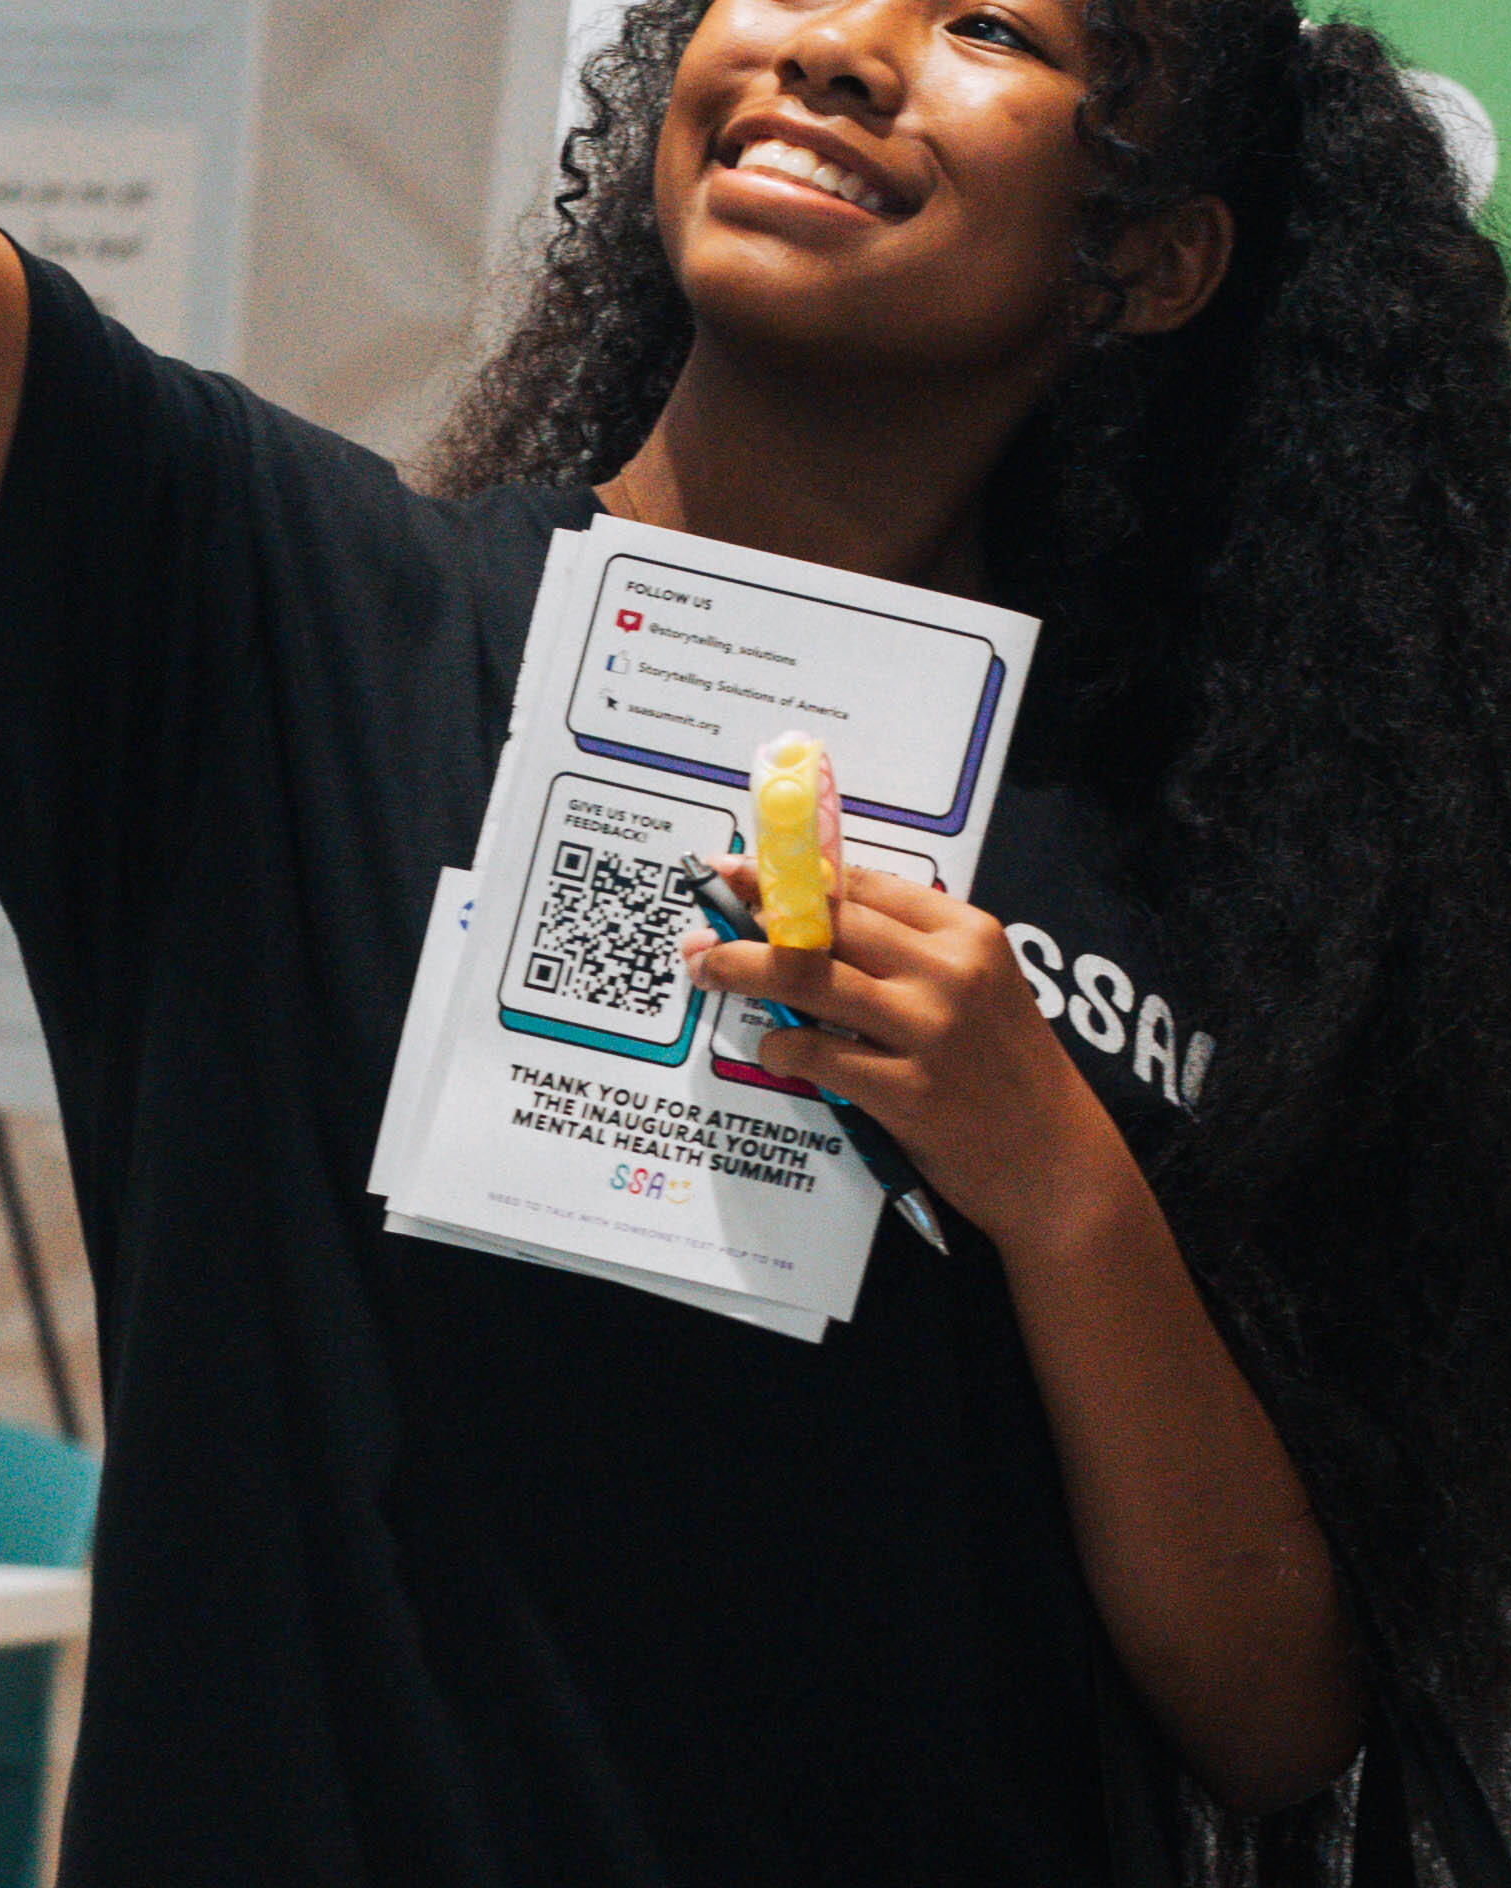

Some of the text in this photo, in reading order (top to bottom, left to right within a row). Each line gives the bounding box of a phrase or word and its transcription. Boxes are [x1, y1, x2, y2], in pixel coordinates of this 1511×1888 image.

[626, 580, 714, 611] FOLLOW US
[637, 661, 850, 721] Storytelling Solutions of America
[626, 702, 722, 737] ssasummit.org
[564, 815, 650, 845] FEEDBACK!
[567, 798, 674, 834] GIVE US YOUR
[510, 1063, 843, 1156] THANK YOU FOR ATTENDING
[532, 1090, 809, 1170] THE INAUGURAL YOUTH
[511, 1108, 816, 1193] MENTAL HEALTH SUMMIT!
[610, 1162, 666, 1200] SSA
